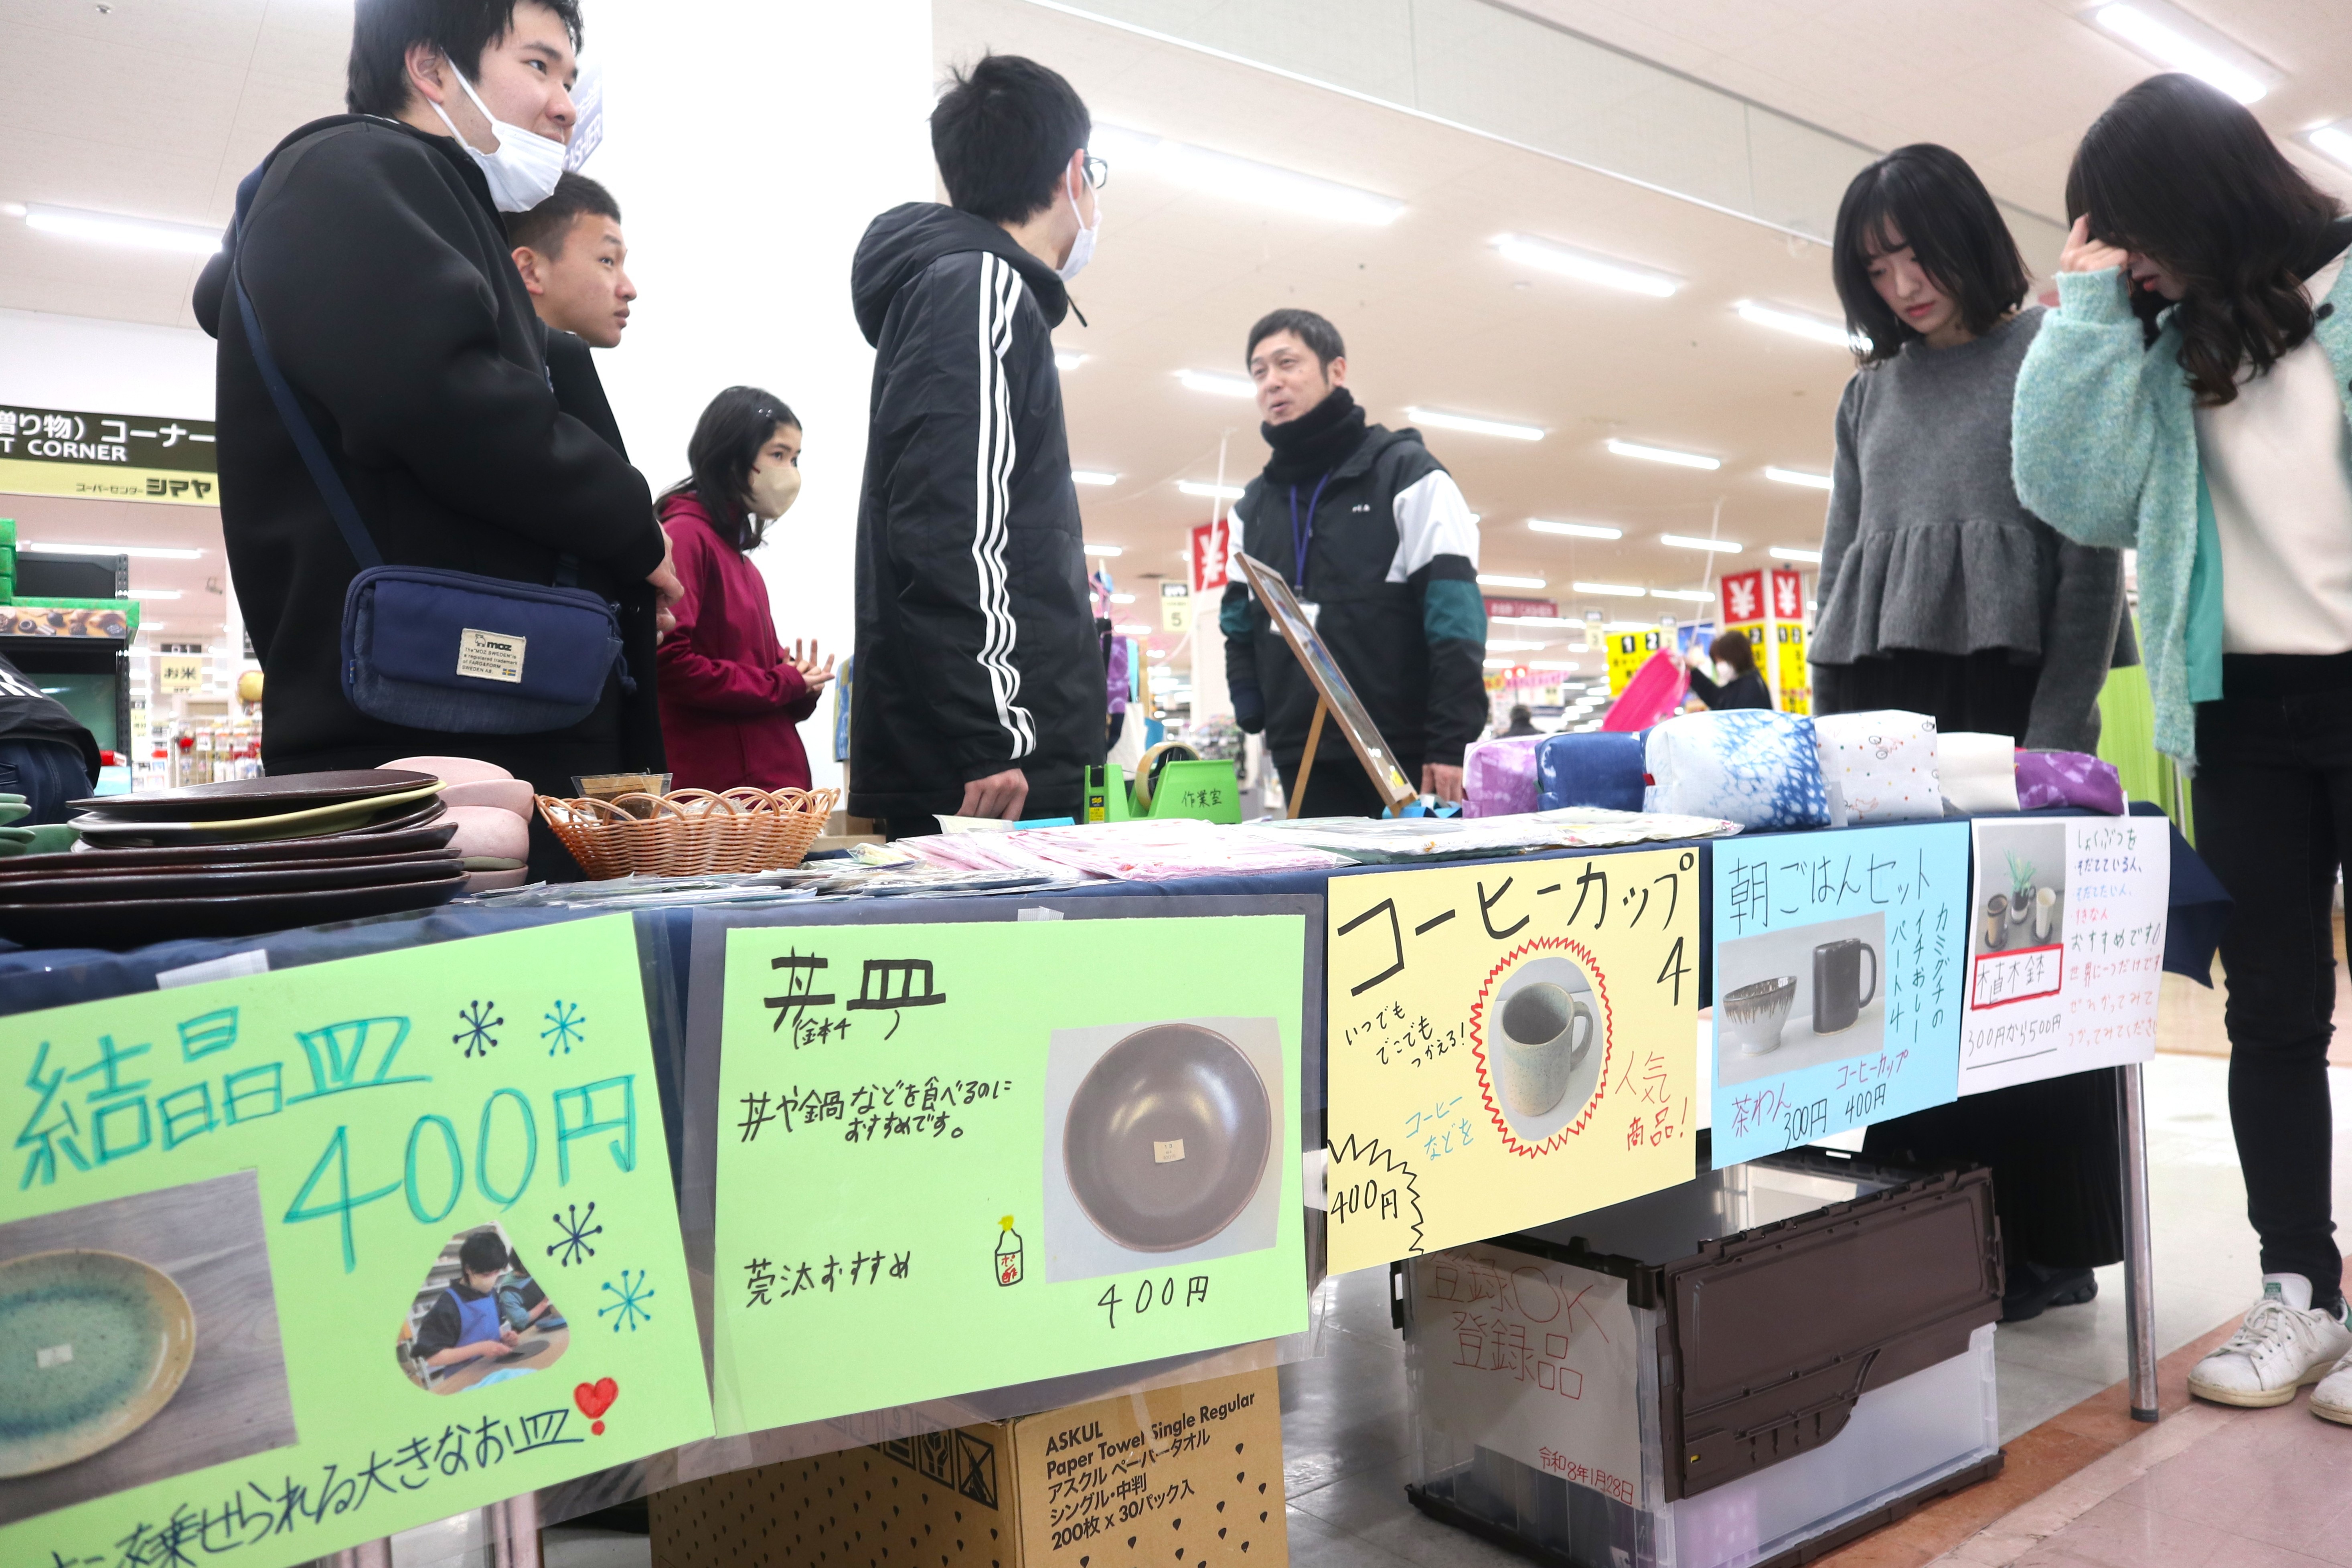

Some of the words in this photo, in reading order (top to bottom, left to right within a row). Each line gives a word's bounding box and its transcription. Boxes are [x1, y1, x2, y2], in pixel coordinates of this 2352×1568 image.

[27, 440, 128, 462] CORNER
[146, 478, 211, 499] シマヤ
[487, 642, 512, 651] moz
[1181, 788, 1222, 808] 作業室
[1728, 847, 1930, 936] 朝ごはんセット
[1337, 852, 1695, 997] コーヒーカップ
[764, 946, 946, 1033] 丼皿
[1656, 936, 1692, 1006] 4
[1932, 902, 1950, 1029] カミグチの
[1977, 954, 2045, 1004] 植木鉢
[1345, 1001, 1406, 1046] いつでも
[1968, 1013, 2062, 1057] 300円から500円
[1615, 1051, 1671, 1104] 人気
[1836, 1049, 1909, 1090] コーヒーカップ
[14, 1005, 433, 1192] 結晶皿
[737, 1076, 1012, 1143] 丼や鍋などを食べるのに
[1405, 1096, 1463, 1138] コーヒー
[1627, 1097, 1688, 1152] 商品!
[1732, 1082, 1792, 1138] 茶わん
[1784, 1098, 1828, 1150] 300円
[1845, 1083, 1886, 1124] 400円
[845, 1111, 964, 1143] おすすめです。
[1424, 1118, 1473, 1161] などを
[282, 1074, 637, 1274] 400円
[1331, 1179, 1398, 1224] 400円
[1097, 1276, 1209, 1329] 400円
[1452, 1311, 1583, 1400] 登録品
[1045, 1421, 1103, 1457] ASKUL
[1047, 1450, 1094, 1479] Paper
[1098, 1432, 1145, 1462] Towel
[1151, 1416, 1195, 1441] Single
[1199, 1391, 1255, 1424] Regular
[1047, 1466, 1107, 1505] アスクル
[1110, 1428, 1211, 1476] ペーパータオル
[1538, 1446, 1634, 1506] 令和8年1月28日
[1049, 1472, 1147, 1527] シングル・中判
[1051, 1517, 1101, 1551] 200枚
[1119, 1478, 1195, 1523] 30パック入
